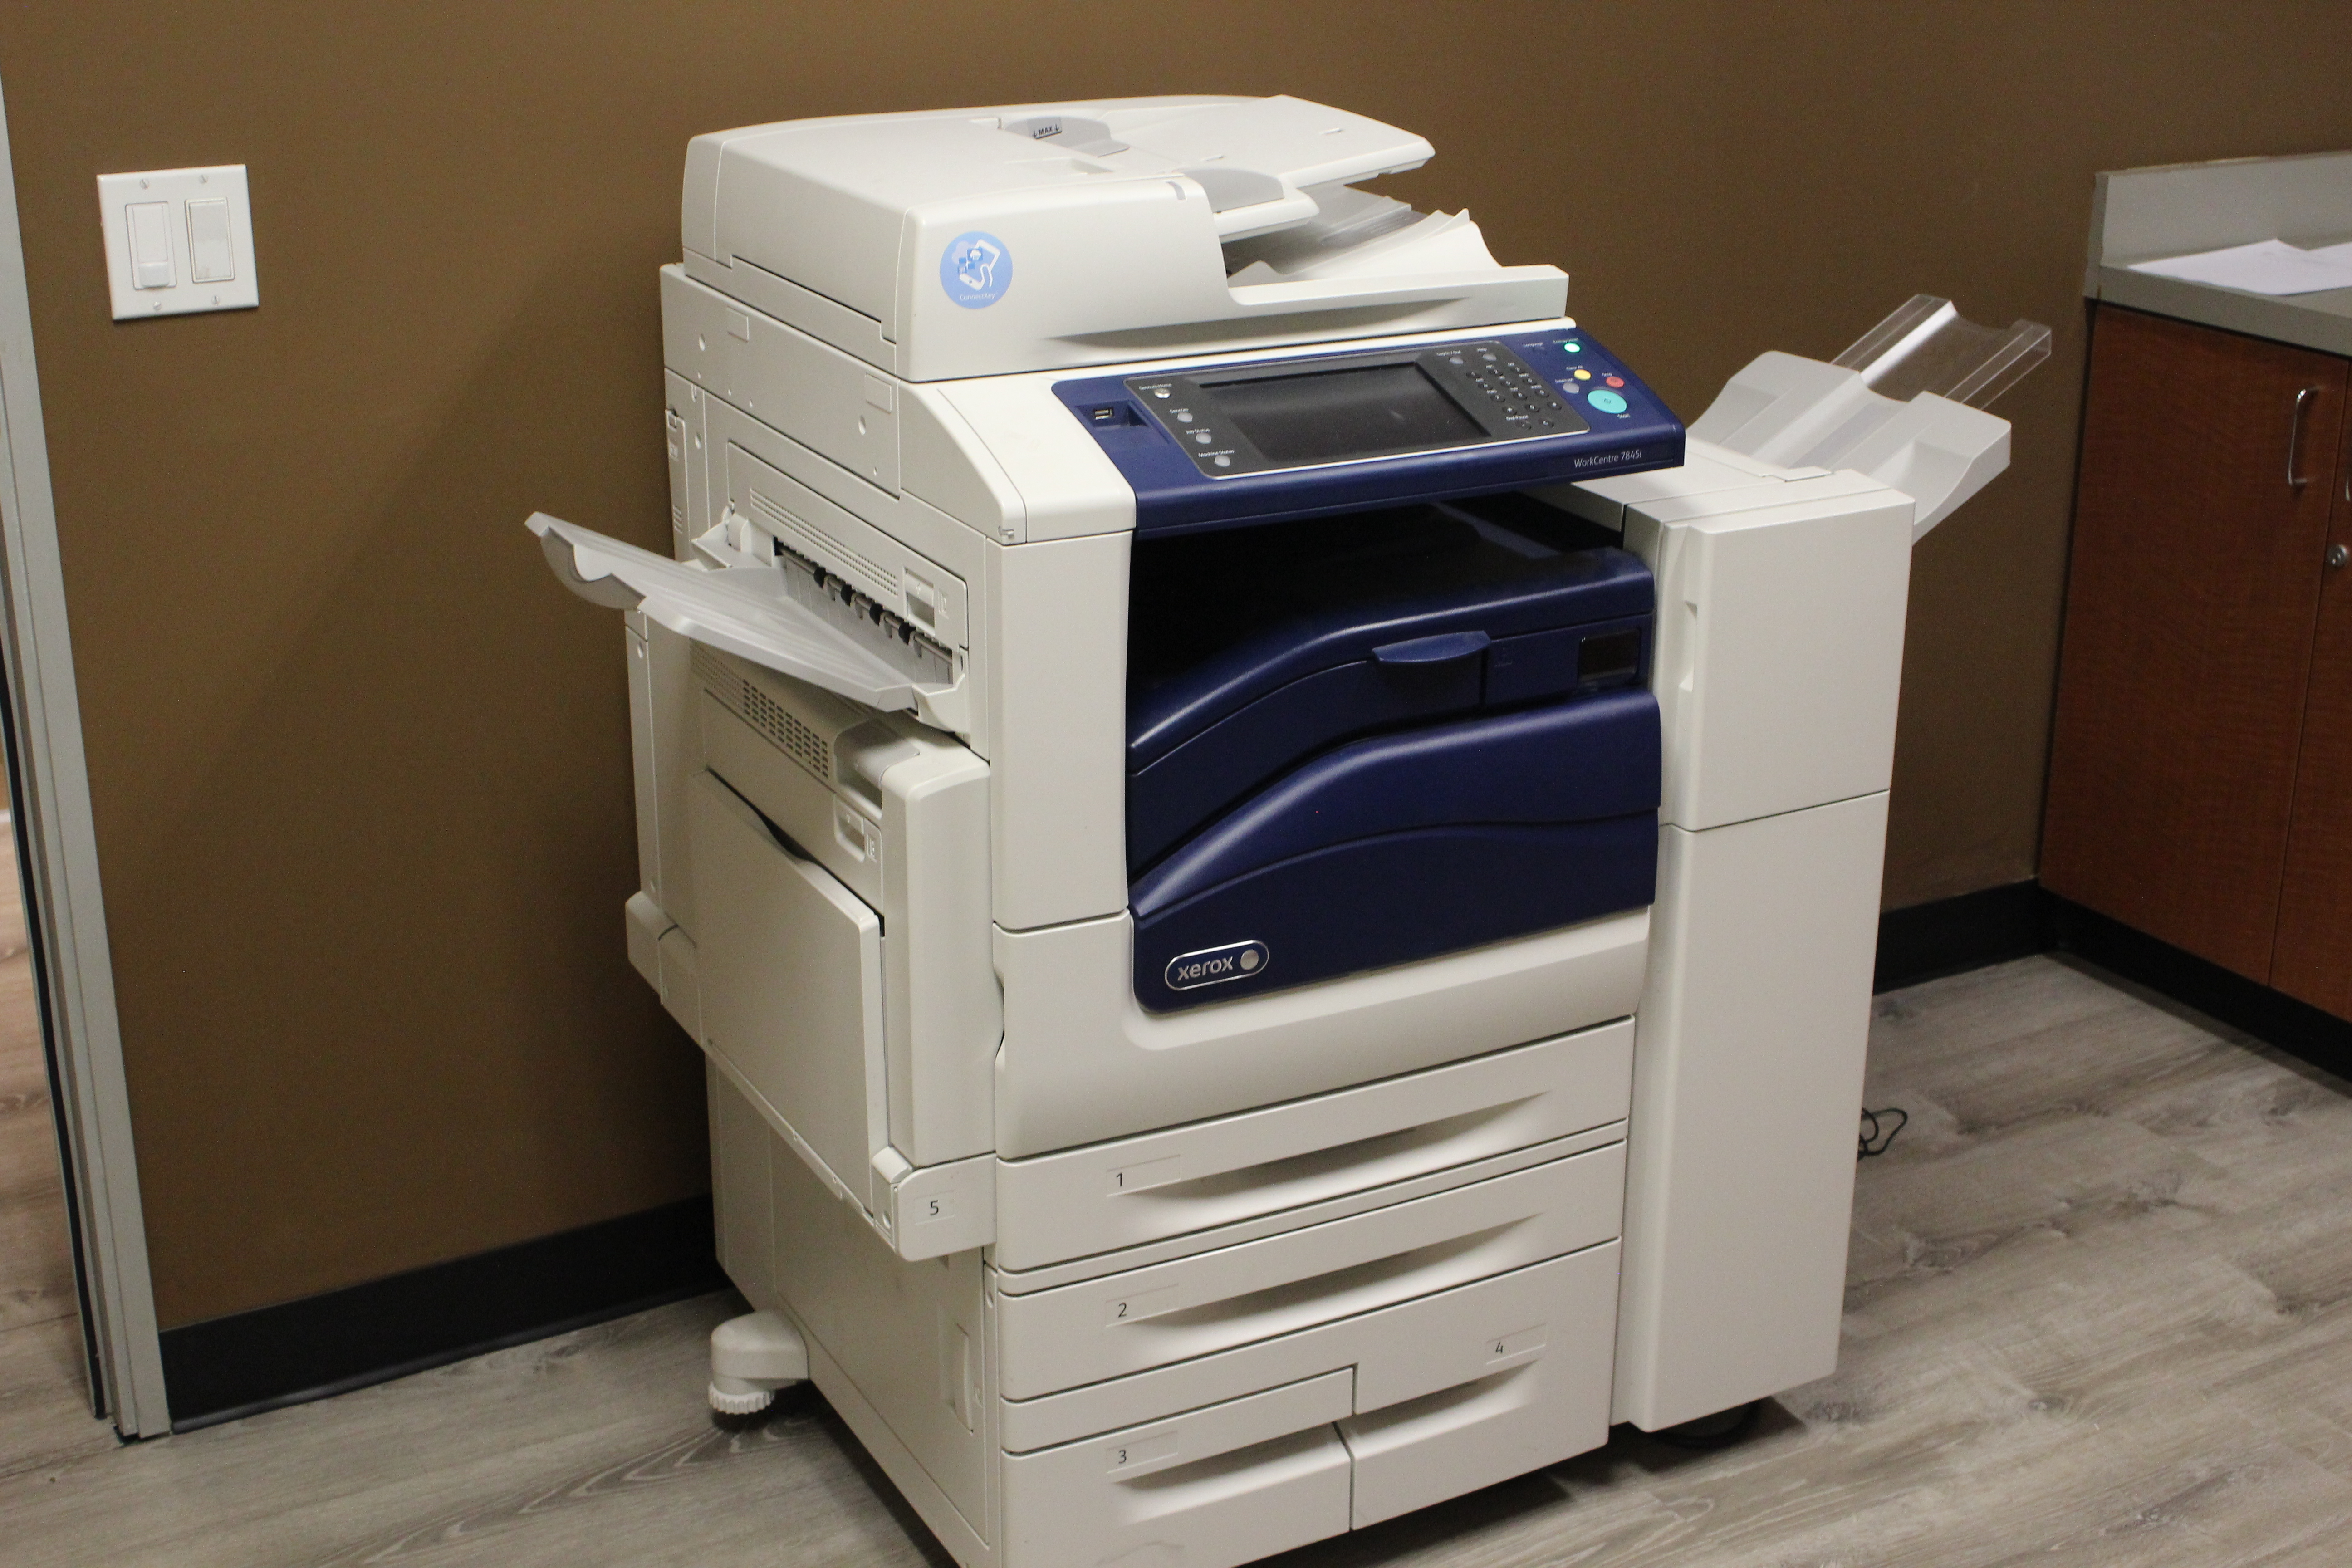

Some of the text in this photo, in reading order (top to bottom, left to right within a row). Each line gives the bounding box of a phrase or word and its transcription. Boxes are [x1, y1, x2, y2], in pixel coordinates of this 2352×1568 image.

[1039, 126, 1052, 135] MAX
[1574, 449, 1642, 468] WorkCentre 7845i
[1177, 956, 1233, 981] xerox
[1116, 1172, 1123, 1187] 1
[930, 1200, 939, 1215] 5
[1118, 1303, 1127, 1318] 2
[1495, 1342, 1504, 1354] 4
[1118, 1449, 1127, 1464] 3
